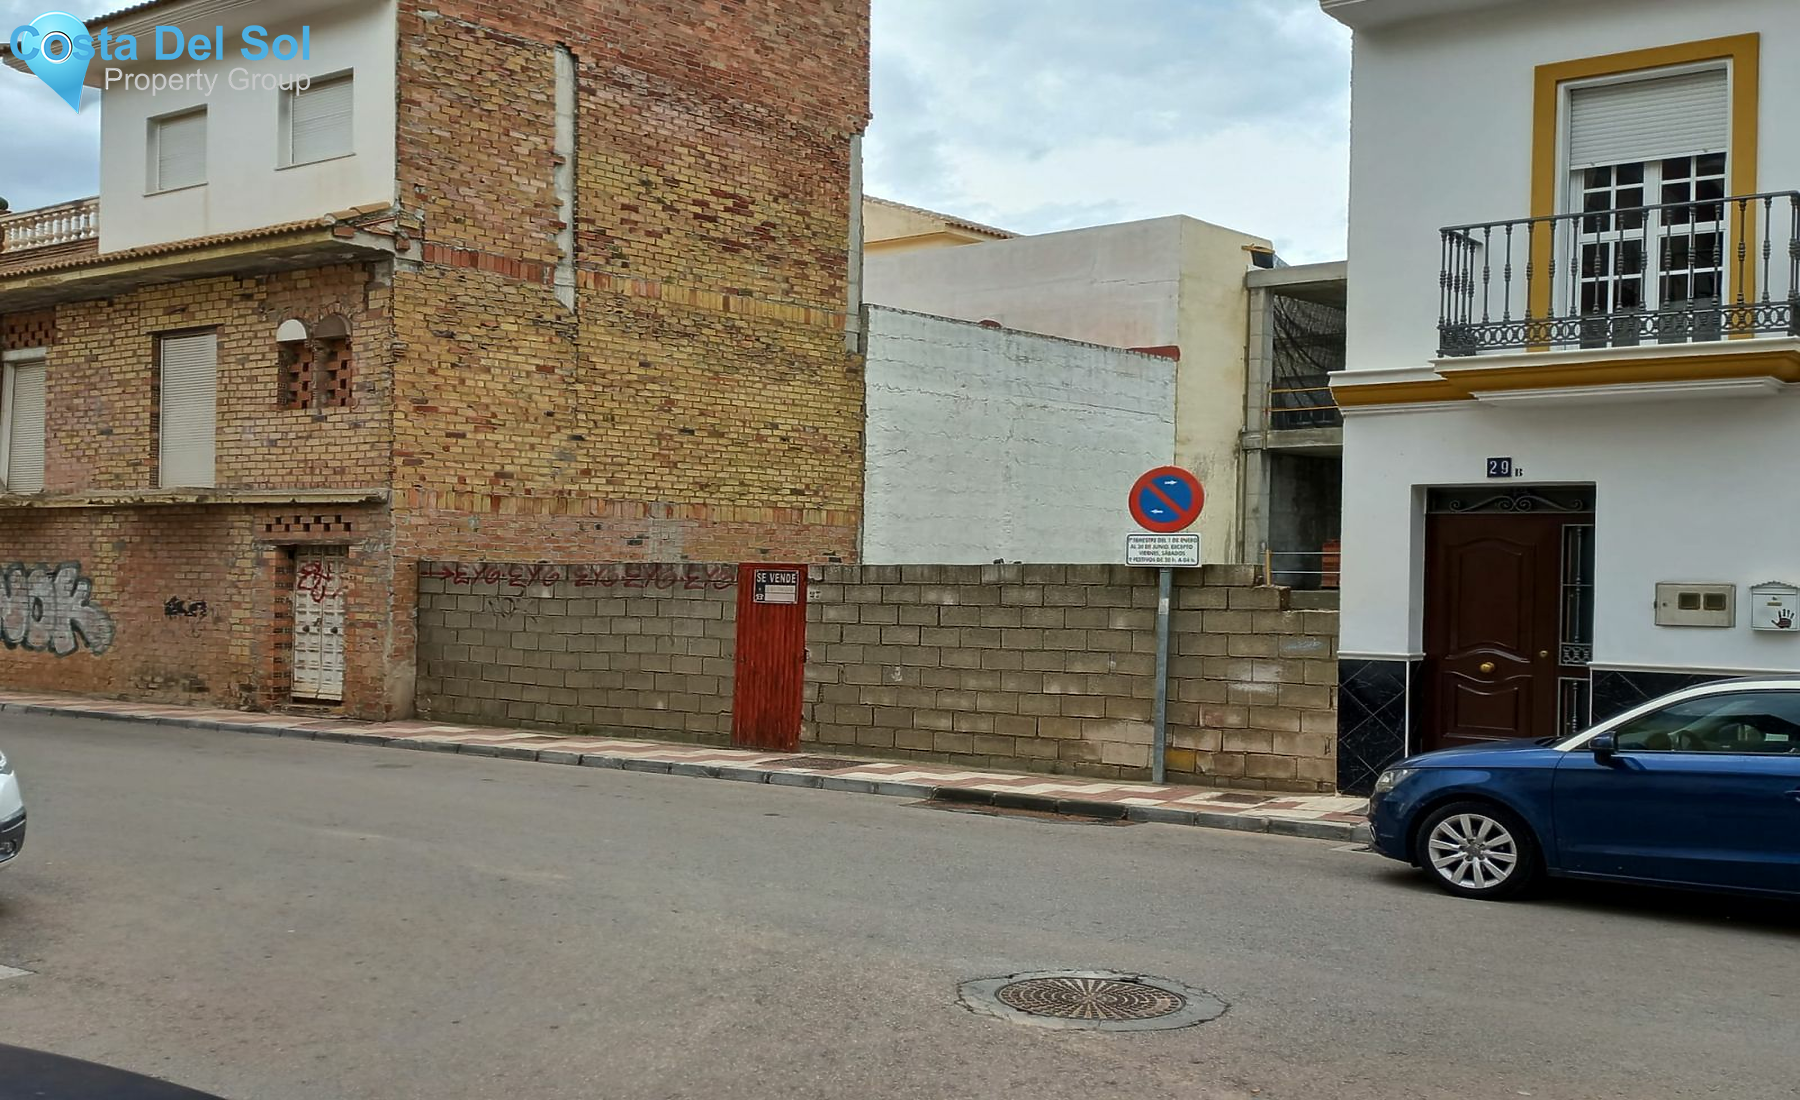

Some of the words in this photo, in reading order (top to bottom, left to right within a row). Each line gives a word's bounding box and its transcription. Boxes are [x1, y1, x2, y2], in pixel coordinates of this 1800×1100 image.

[1490, 460, 1509, 475] 29
[756, 572, 767, 583] SE
[769, 572, 796, 584] VENDE
